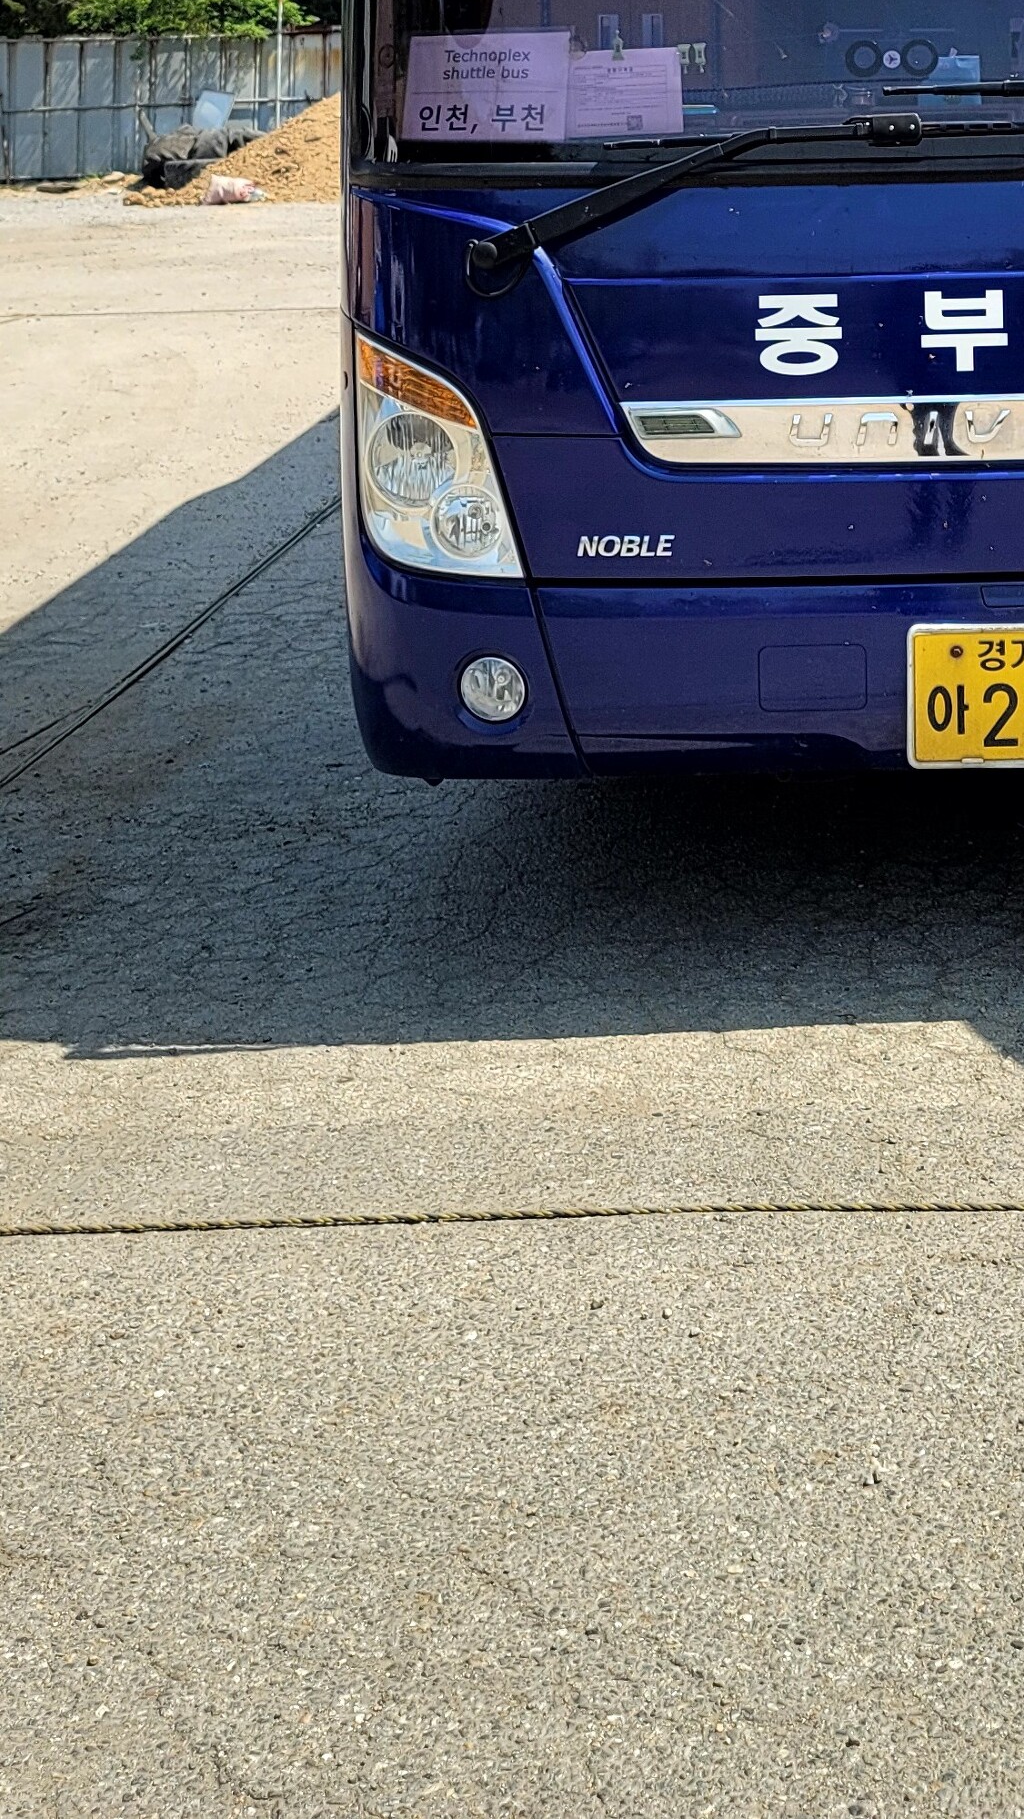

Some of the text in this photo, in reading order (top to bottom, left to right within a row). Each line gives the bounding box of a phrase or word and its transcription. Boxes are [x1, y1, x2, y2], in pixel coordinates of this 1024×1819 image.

[444, 48, 531, 65] Technoplex
[442, 66, 530, 80] shuttle bus
[418, 104, 546, 134] 인천, 부천
[577, 534, 676, 557] NOBLE
